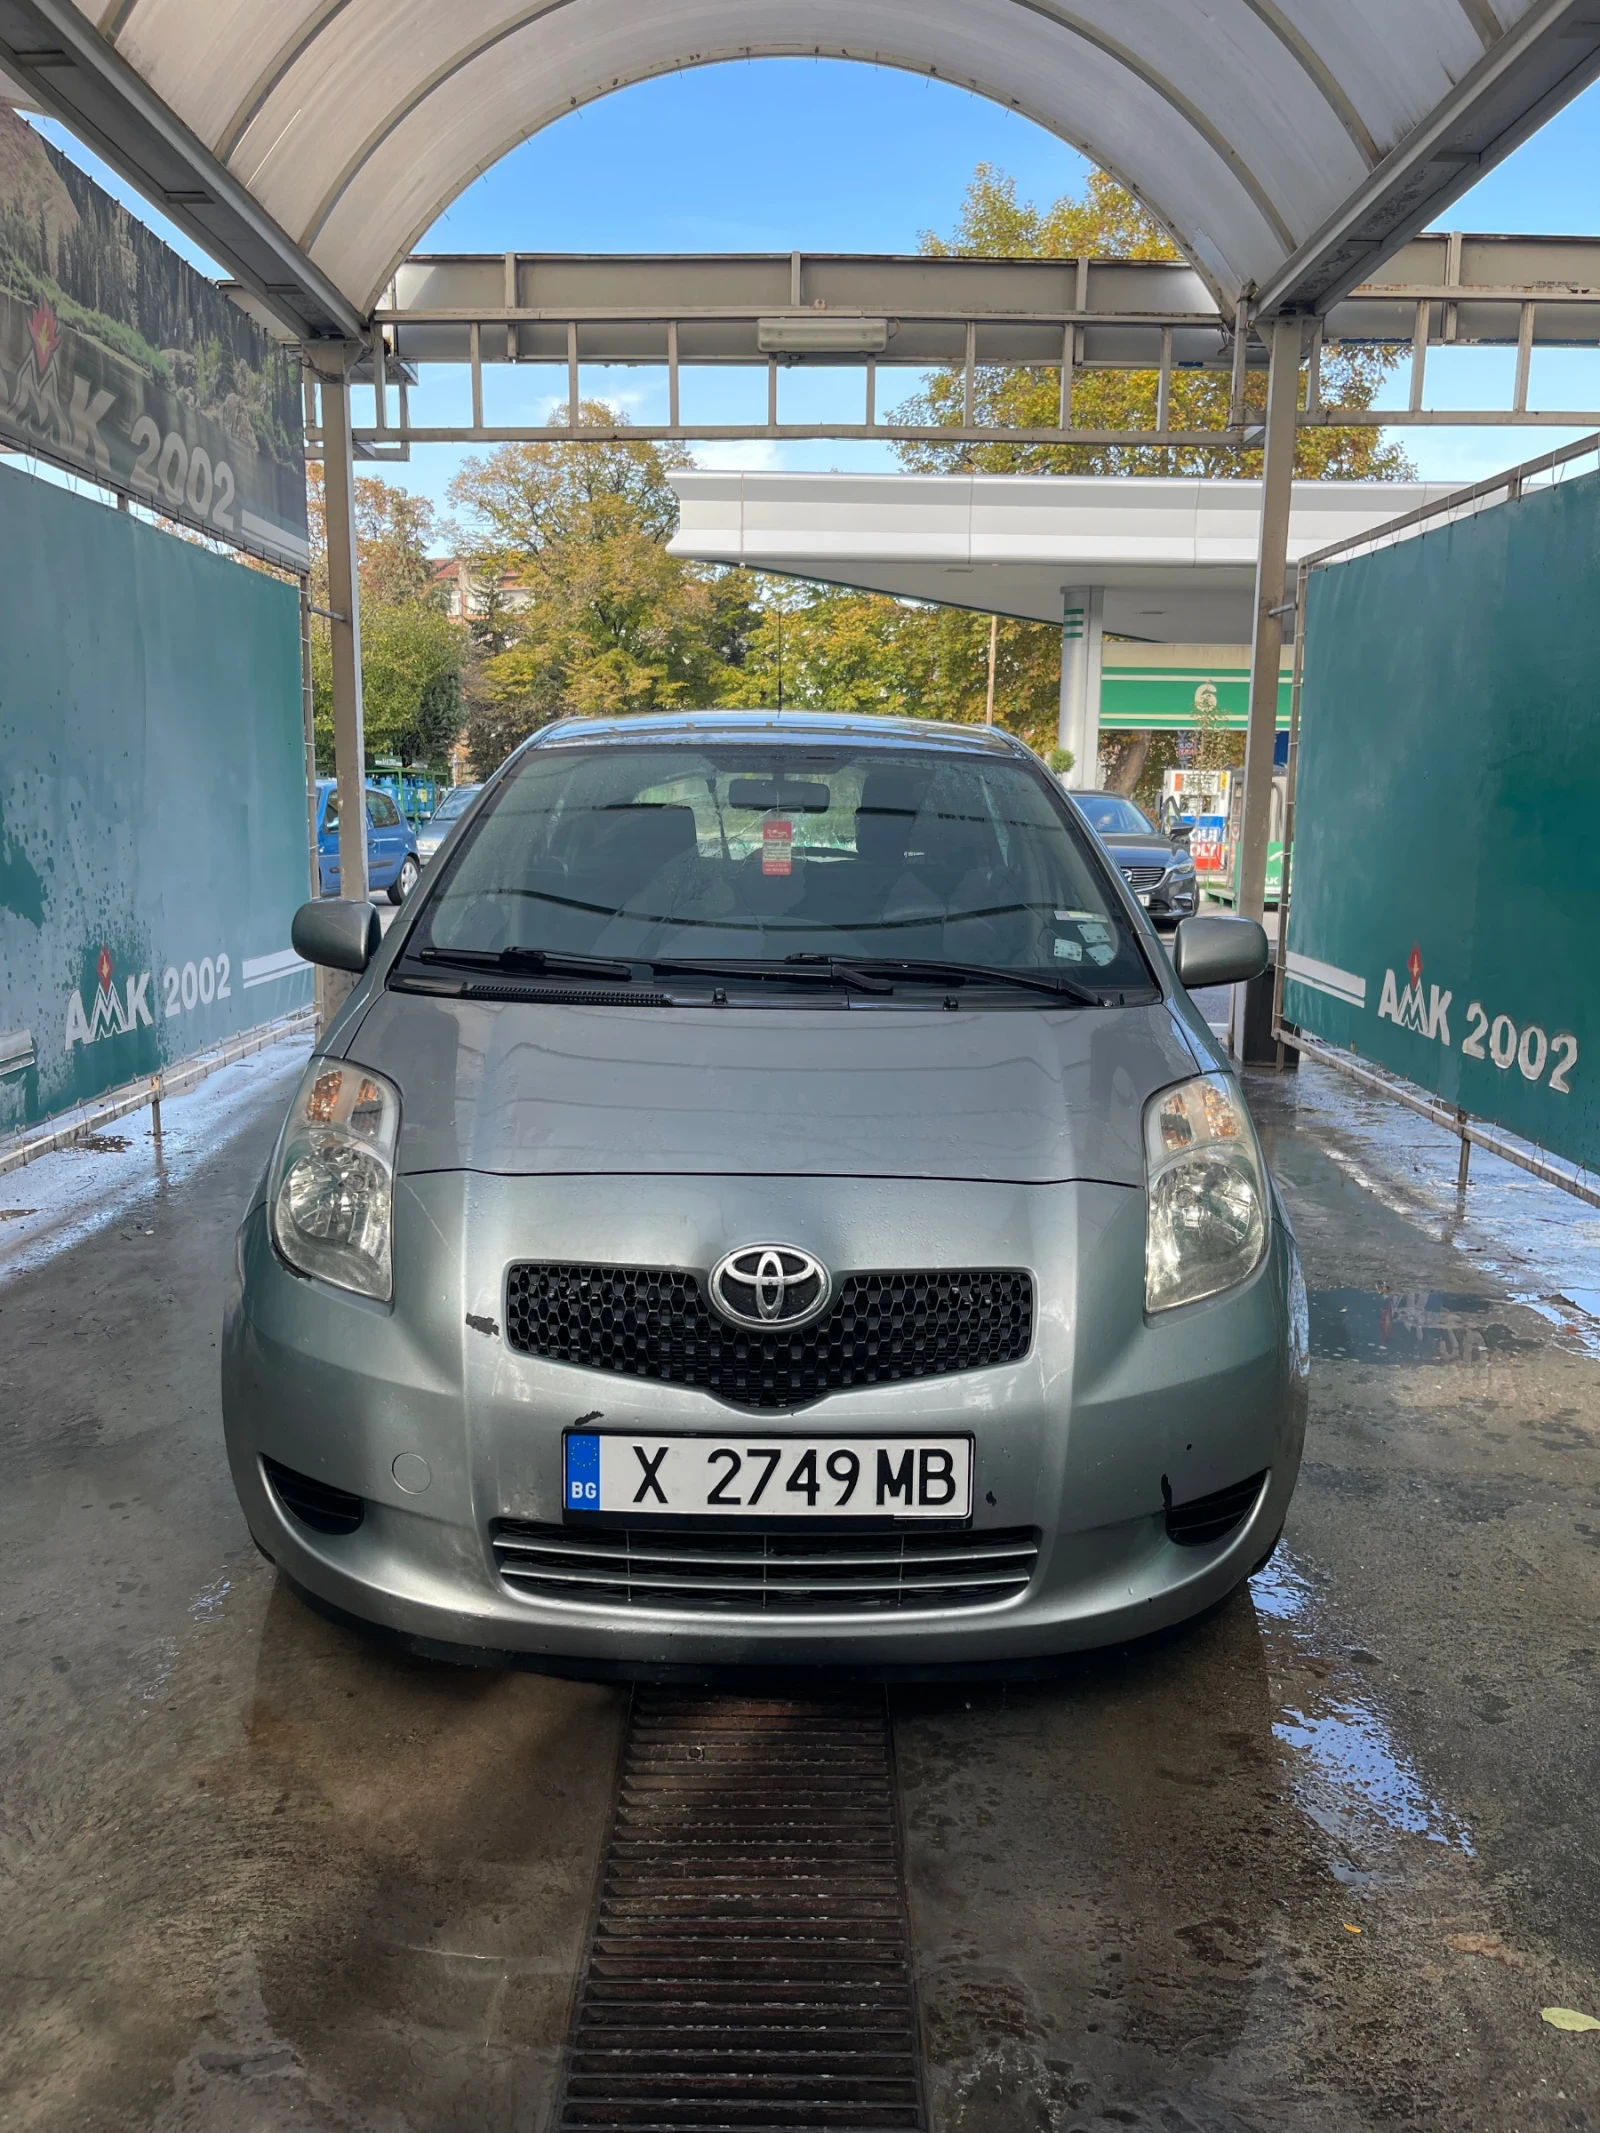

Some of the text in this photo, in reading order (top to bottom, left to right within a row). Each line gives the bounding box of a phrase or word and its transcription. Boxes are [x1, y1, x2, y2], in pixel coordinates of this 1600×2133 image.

[130, 415, 236, 532] 2002
[1188, 829, 1218, 843] QUI
[1190, 843, 1217, 857] OLY
[64, 953, 231, 1051] AMK 2002
[1378, 968, 1578, 1094] AMK 2002
[571, 1480, 597, 1499] BG
[632, 1445, 957, 1506] X 2749 MB
